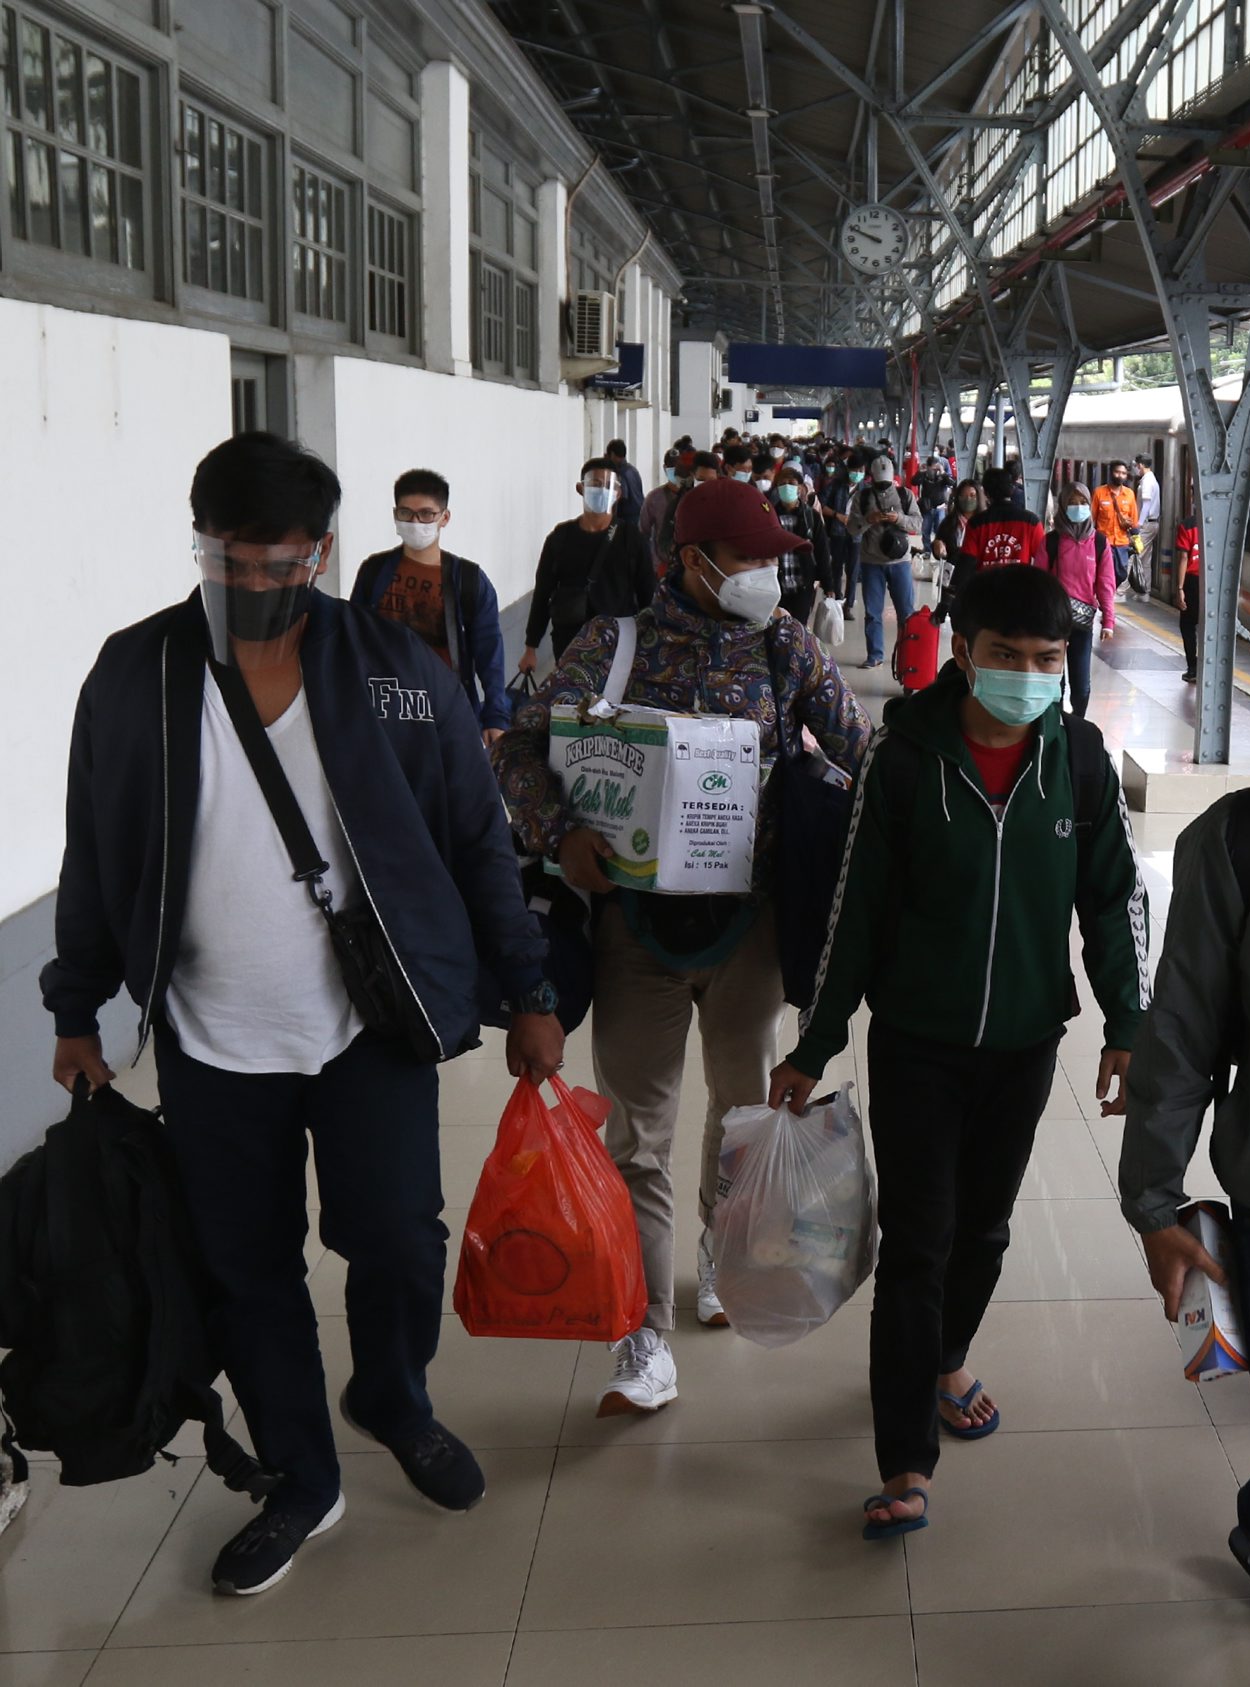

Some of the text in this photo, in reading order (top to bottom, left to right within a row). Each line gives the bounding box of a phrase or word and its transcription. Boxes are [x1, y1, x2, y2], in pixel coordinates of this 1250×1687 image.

[869, 210, 880, 219] 12
[857, 215, 867, 223] 11
[892, 223, 899, 231] 2
[847, 235, 855, 243] 9
[896, 235, 903, 243] 3
[851, 246, 859, 255] 8
[860, 256, 868, 264] 7
[872, 259, 880, 267] 6
[704, 861, 713, 869] 15
[714, 861, 729, 869] Pak
